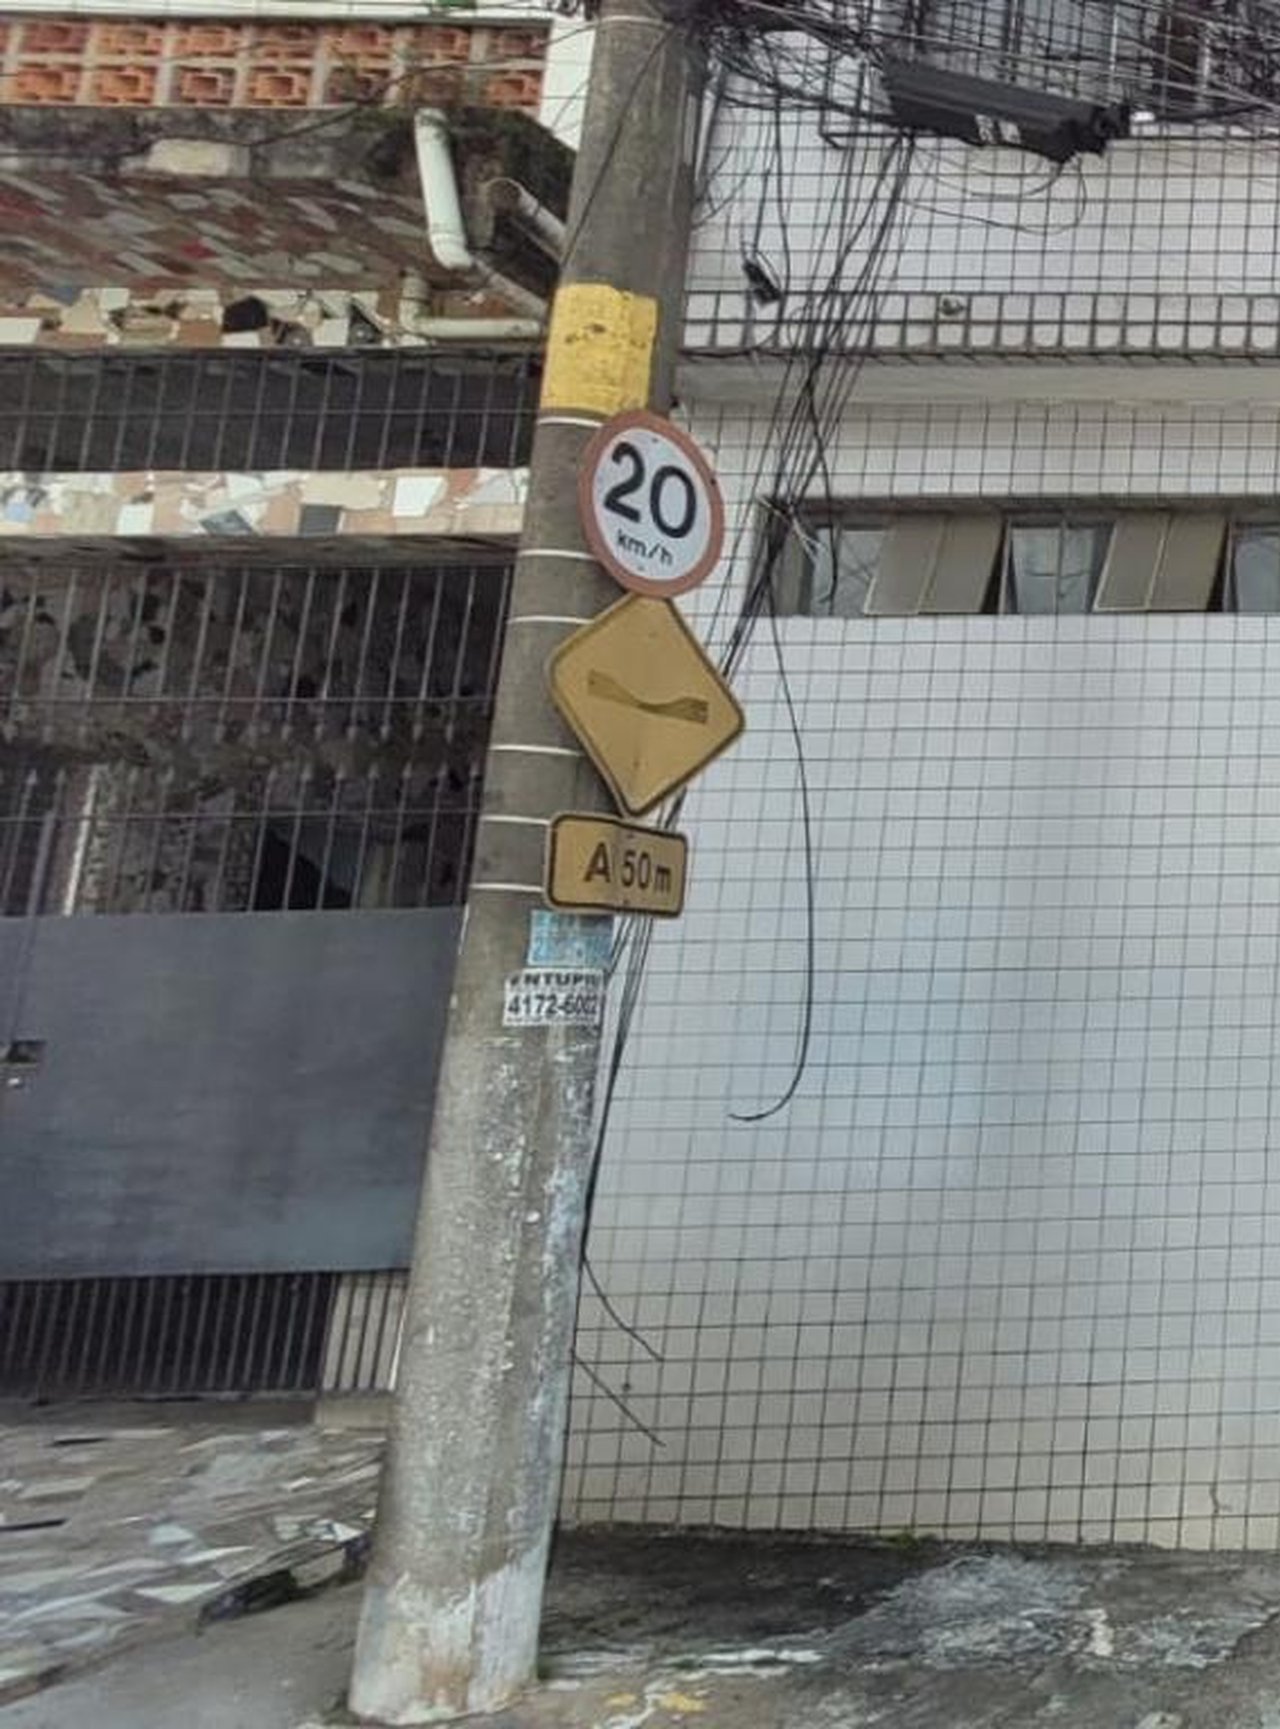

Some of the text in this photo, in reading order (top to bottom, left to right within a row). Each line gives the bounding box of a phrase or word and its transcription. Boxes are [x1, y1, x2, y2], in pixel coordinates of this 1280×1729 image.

[603, 441, 697, 539] 20
[616, 528, 674, 566] km/h
[584, 841, 611, 883] A
